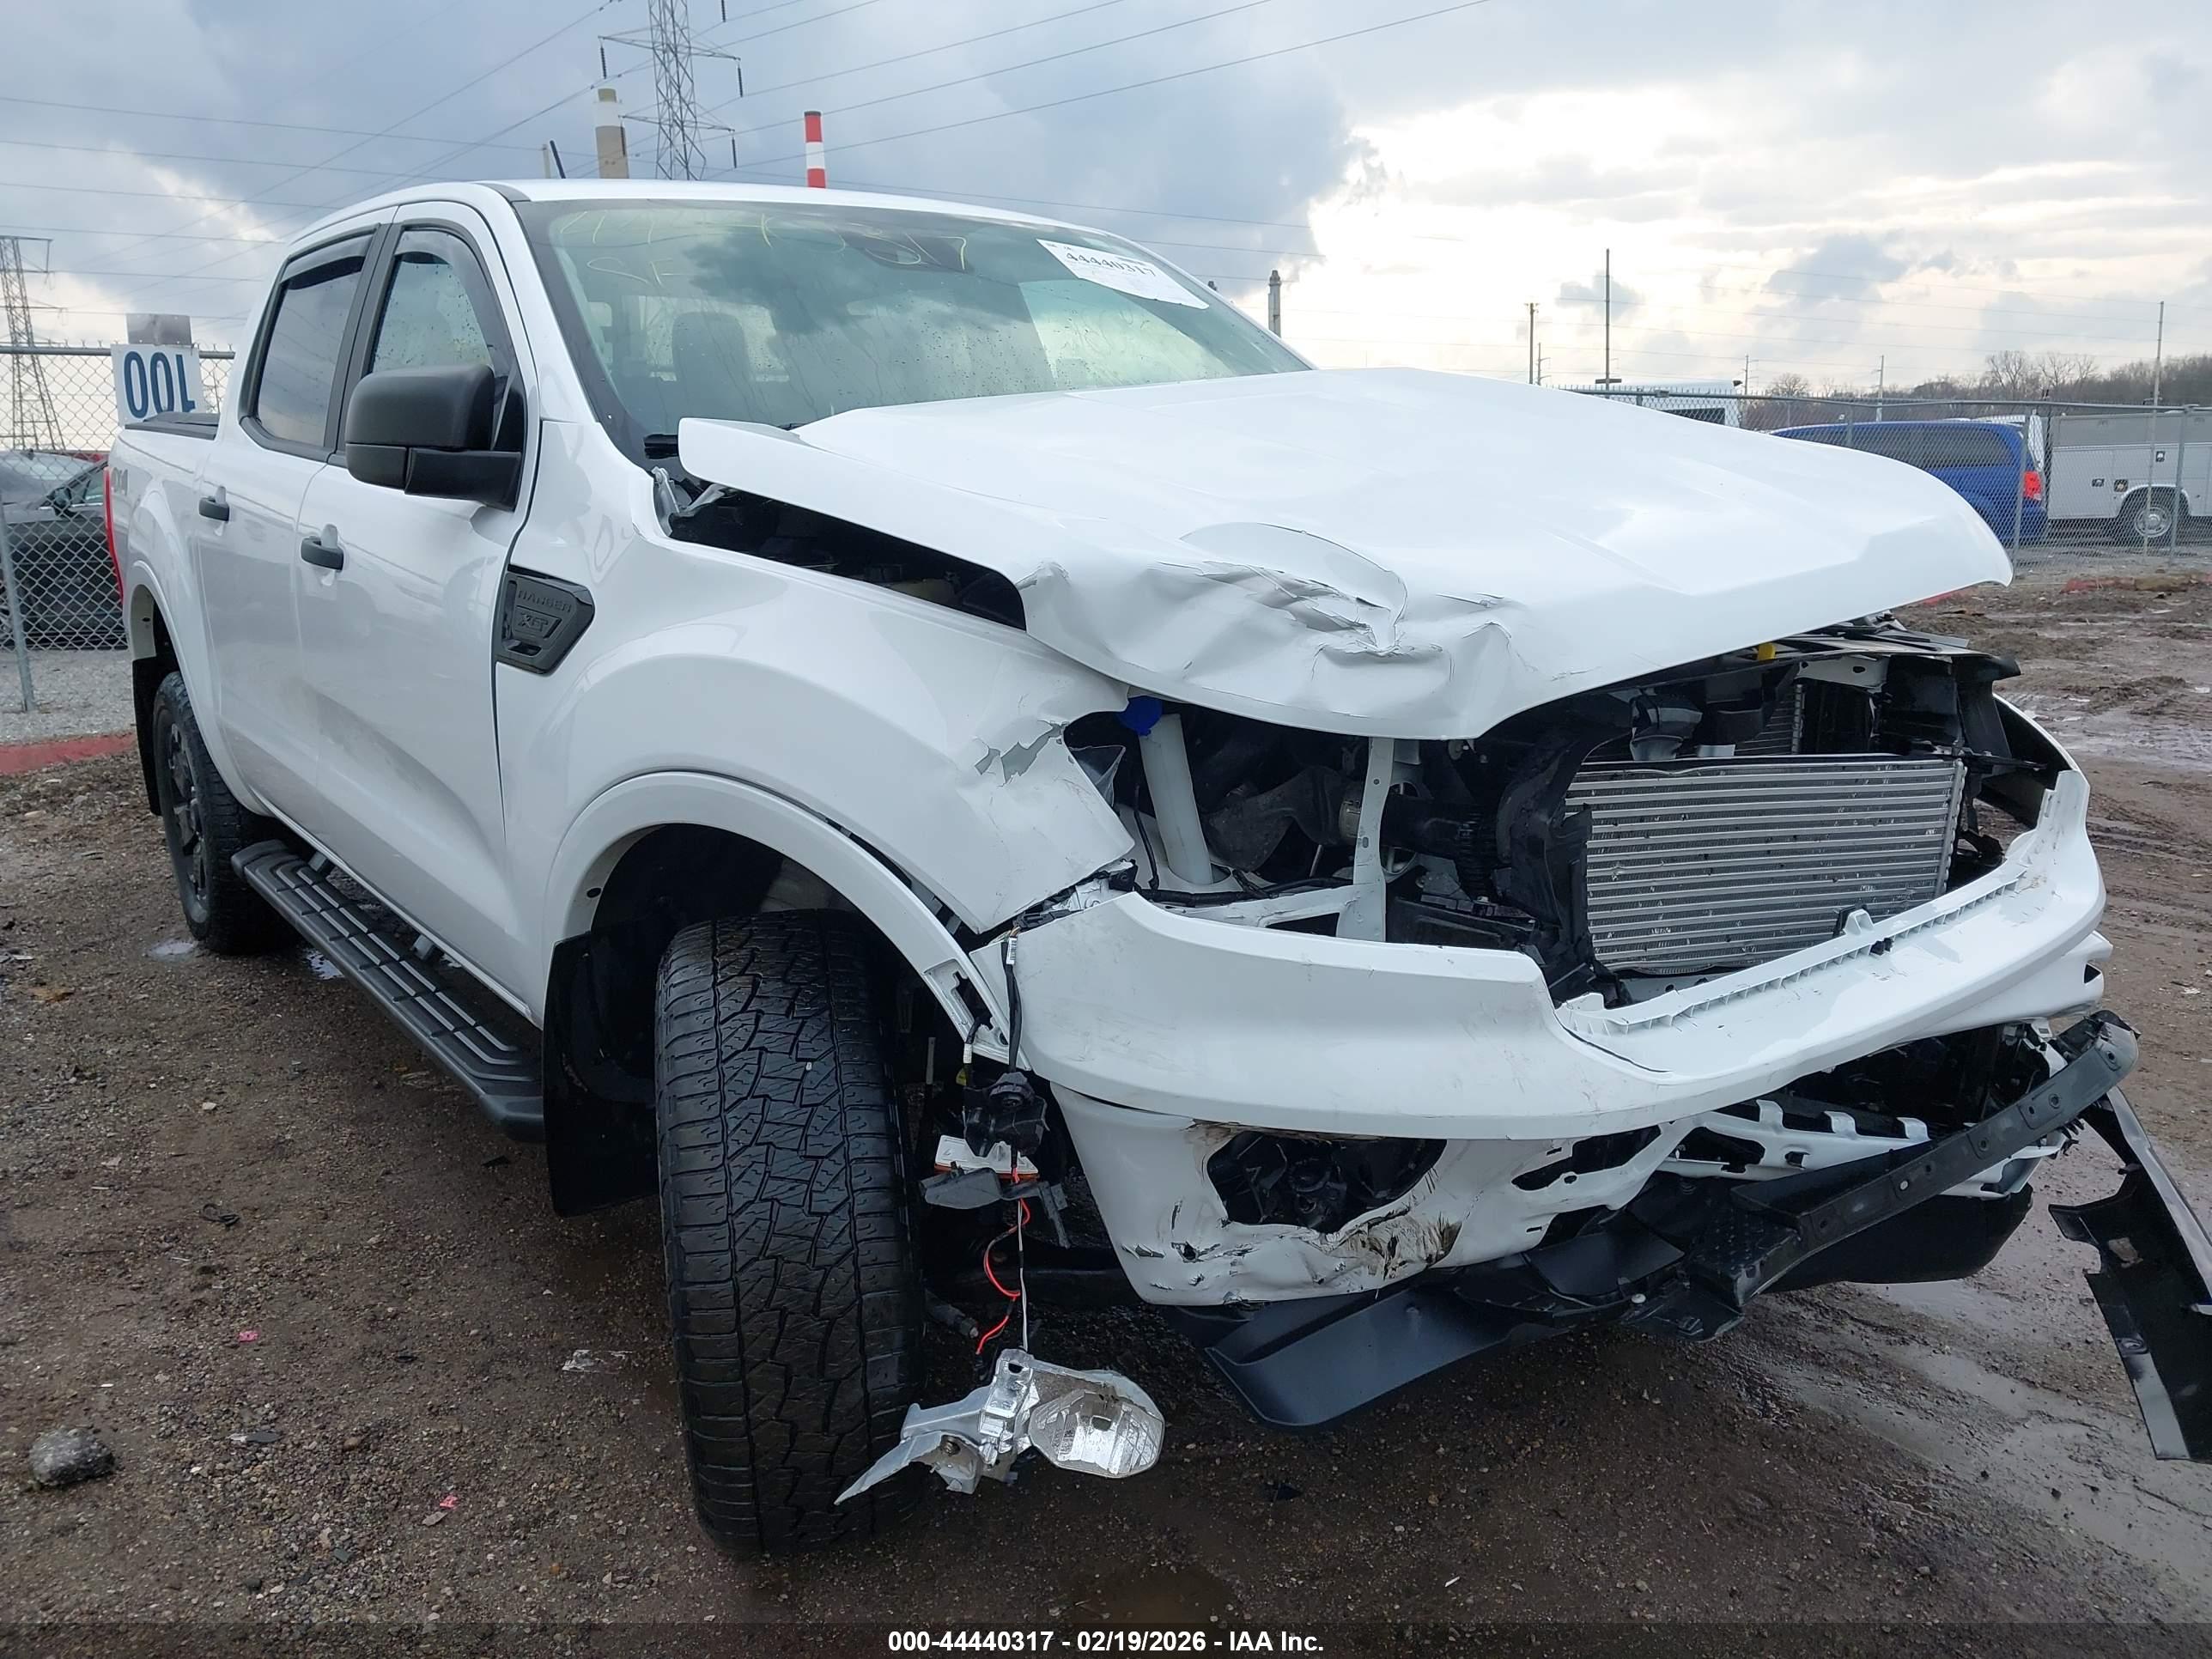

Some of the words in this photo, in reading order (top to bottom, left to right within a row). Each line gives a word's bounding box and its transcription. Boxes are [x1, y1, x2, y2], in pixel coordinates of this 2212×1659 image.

[124, 350, 196, 419] 100
[518, 590, 572, 613] RANGER
[517, 611, 550, 632] XLT
